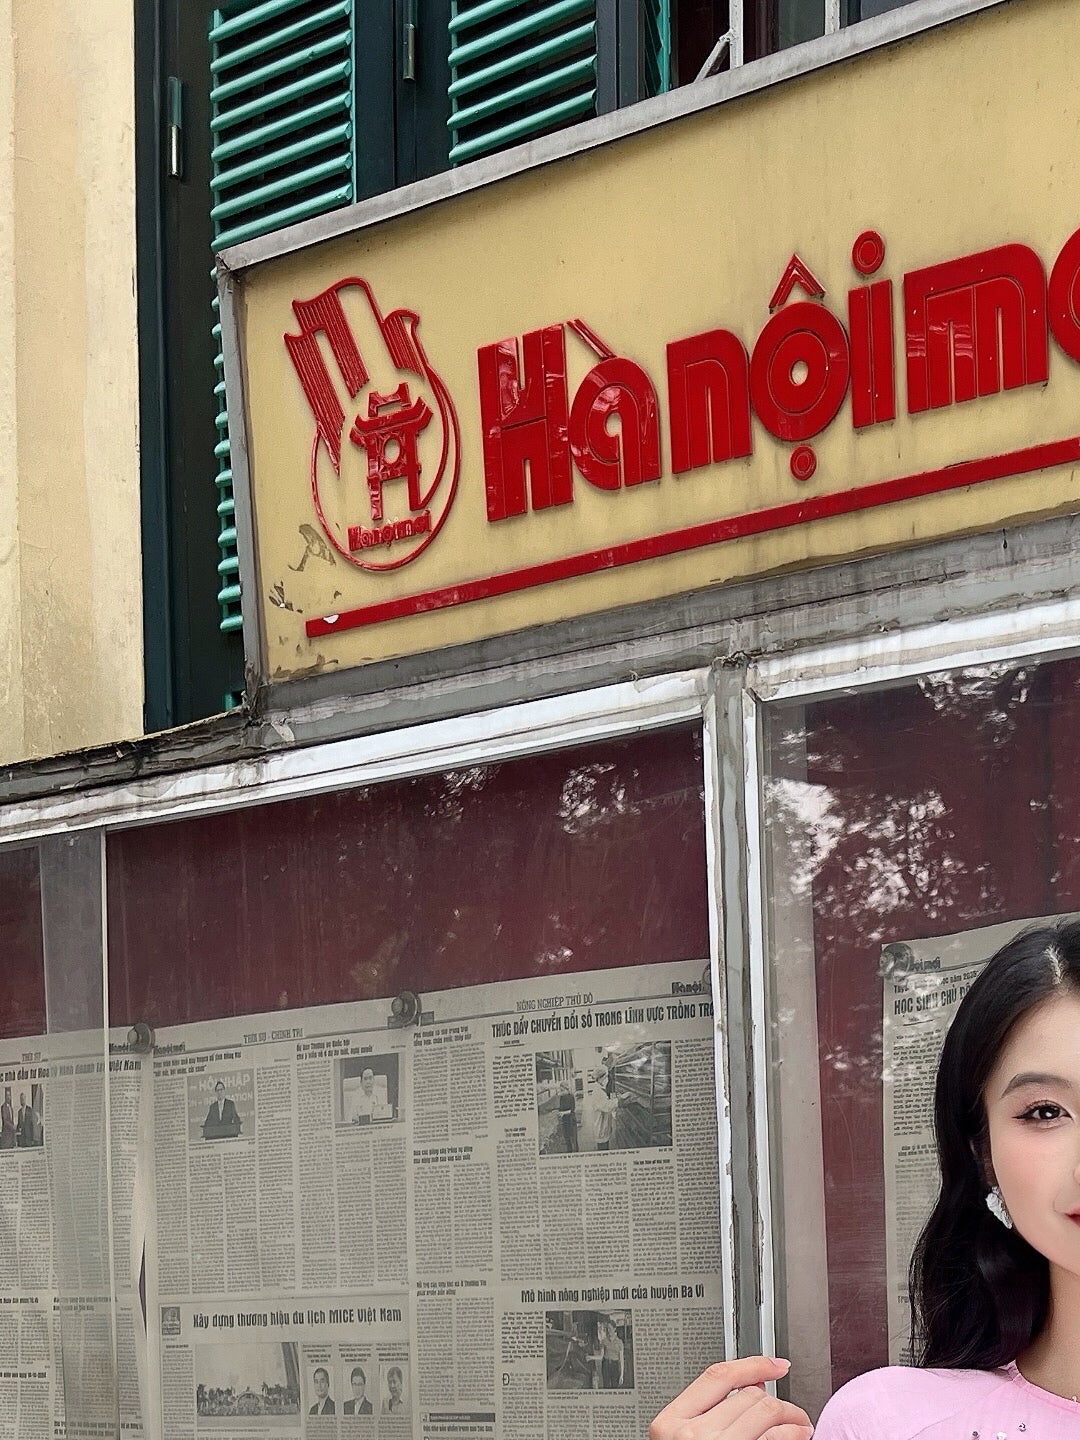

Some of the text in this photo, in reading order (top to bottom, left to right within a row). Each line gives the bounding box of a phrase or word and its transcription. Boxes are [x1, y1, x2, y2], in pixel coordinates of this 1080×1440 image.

[894, 997, 914, 1017] HỌC
[941, 984, 957, 1006] CHỦ
[492, 1020, 512, 1038] THÚC
[513, 1014, 529, 1035] ĐẨY
[531, 1011, 562, 1034] CHUYỂN
[564, 1008, 579, 1030] ĐỔI
[581, 1011, 593, 1028] SỐ
[594, 1011, 622, 1027] TRONG
[667, 999, 696, 1019] TRỒNG
[558, 1287, 579, 1303] nông
[581, 1286, 610, 1303] nghiệp
[613, 1286, 629, 1300] mới
[631, 1284, 648, 1299] của
[650, 1285, 679, 1302] huyện
[681, 1285, 693, 1298] Ba
[193, 1307, 402, 1330] Xây dựng thương hiệu du lịch MICE Việt Nam
